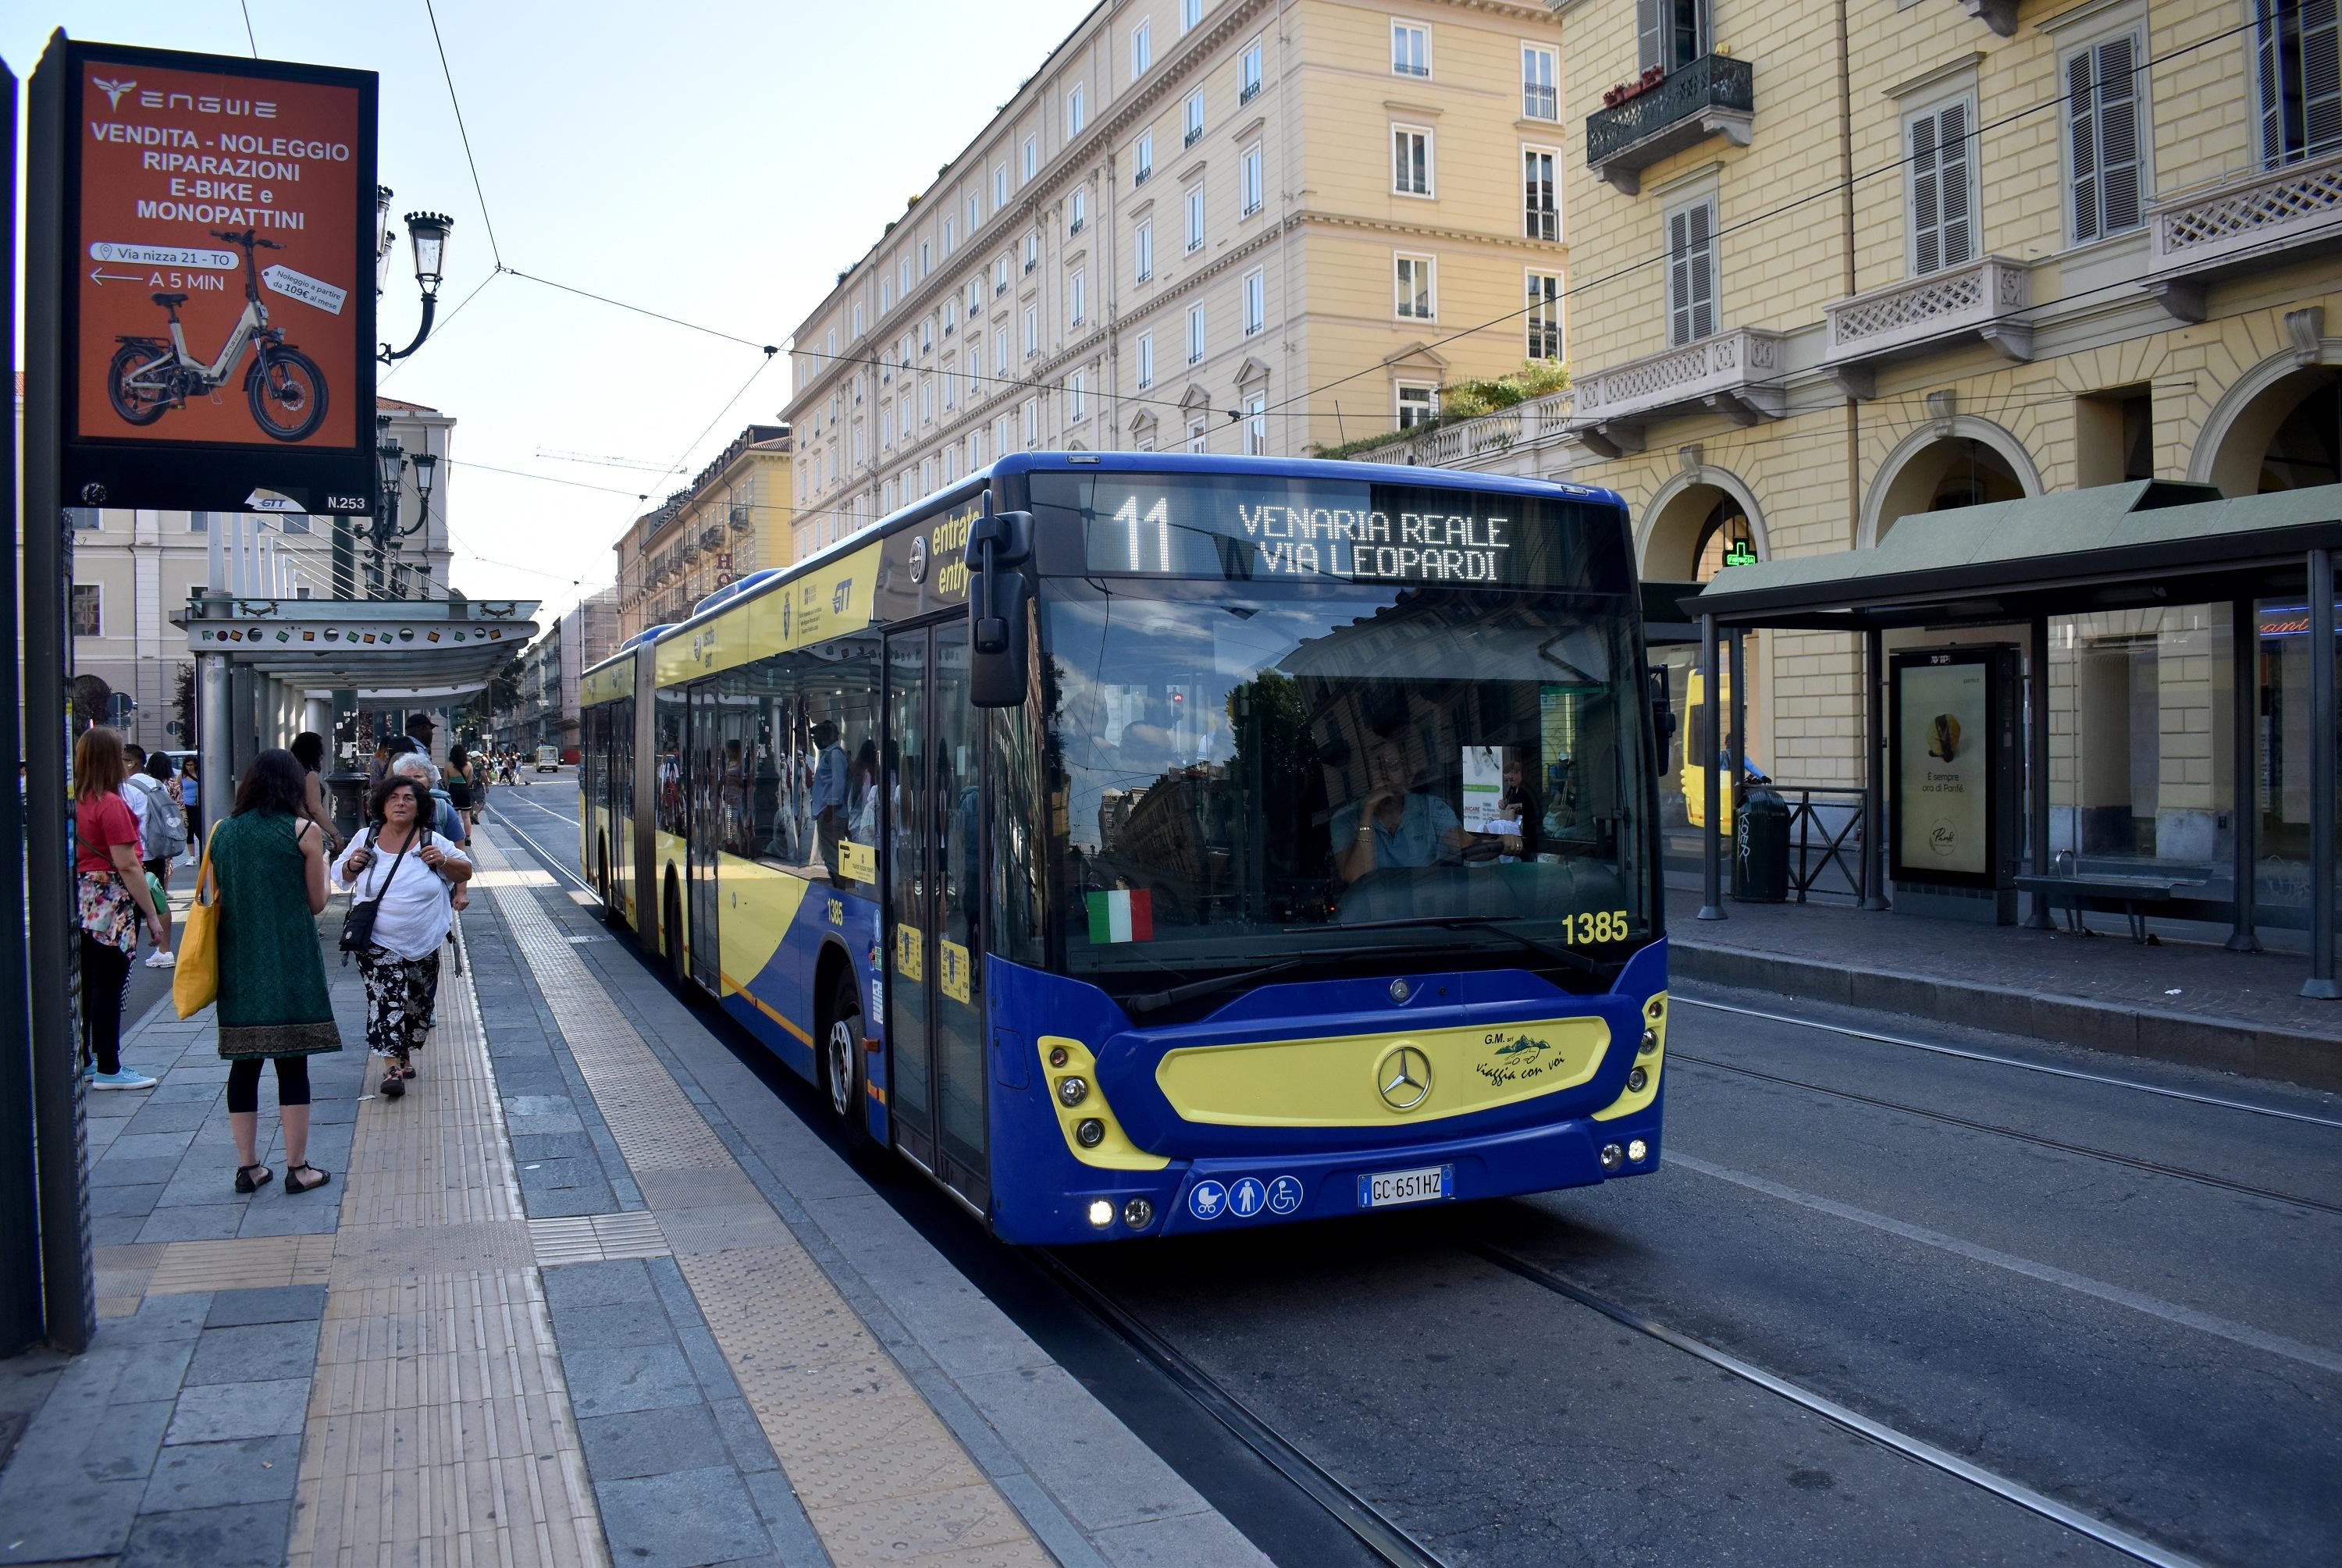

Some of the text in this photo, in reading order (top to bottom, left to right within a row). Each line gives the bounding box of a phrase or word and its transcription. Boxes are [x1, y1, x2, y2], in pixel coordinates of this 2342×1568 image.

[91, 122, 199, 148] VENDITA
[221, 133, 350, 162] NOLEGGIO
[144, 151, 300, 181] RIPARAZIONI
[171, 178, 273, 203] E-BIKE e
[137, 200, 304, 229] MONOPATTINI
[118, 248, 139, 261] Via
[143, 249, 176, 262] nizza
[181, 252, 197, 264] 21
[211, 254, 230, 266] TO
[149, 272, 224, 291] A 5 MIN
[277, 270, 309, 288] Noleggio
[316, 286, 341, 300] partire
[284, 284, 310, 299] 109€
[318, 298, 337, 310] mese
[328, 496, 365, 510] N.253
[1113, 496, 1169, 571] 11
[1239, 504, 1509, 547] VENARIA REALE
[1260, 541, 1497, 580] VIA LEOPARDI
[939, 556, 969, 597] entry
[832, 578, 852, 615] GTT
[1934, 773, 1959, 783] sempre
[1936, 784, 1942, 792] di
[828, 898, 843, 926] 1385
[1562, 910, 1628, 945] 1385
[1485, 1033, 1505, 1045] G.M.
[1521, 1067, 1543, 1079] con
[1548, 1051, 1565, 1071] voi
[1372, 1173, 1440, 1200] GC 651HZ
